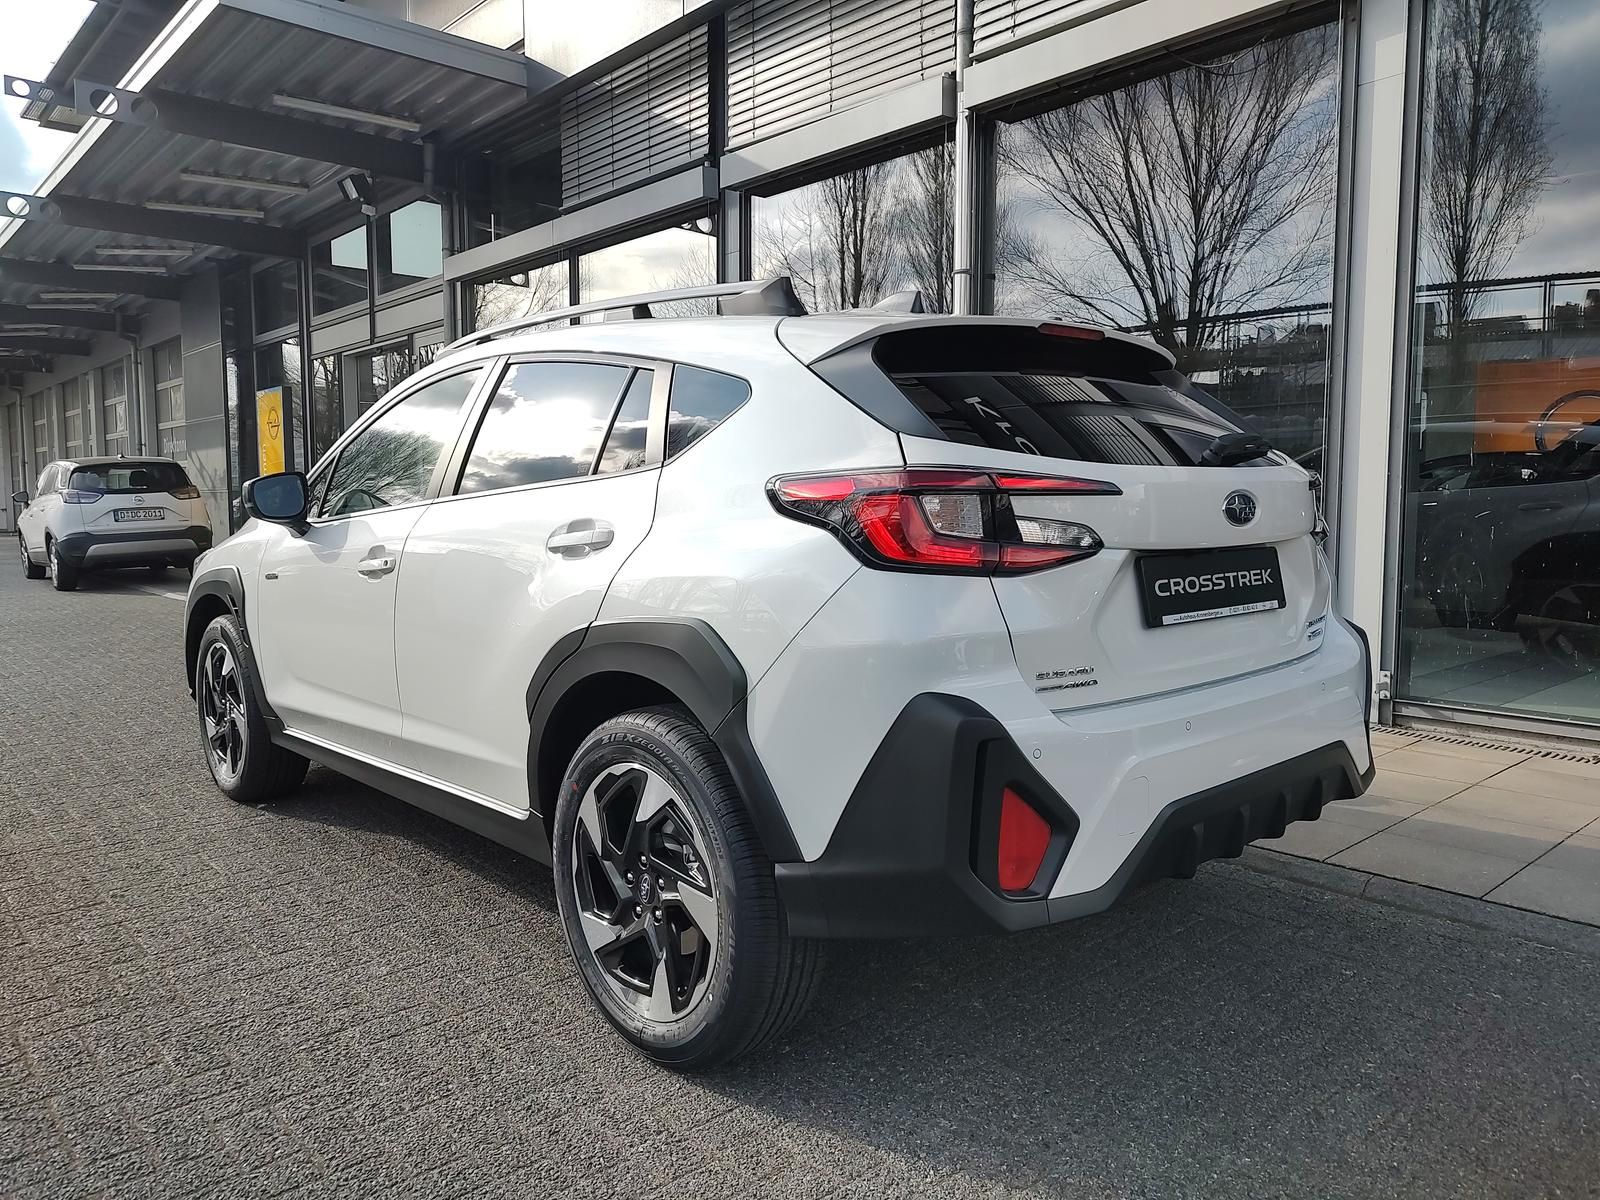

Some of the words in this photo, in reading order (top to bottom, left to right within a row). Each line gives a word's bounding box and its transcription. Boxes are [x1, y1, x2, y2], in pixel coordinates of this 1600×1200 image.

[143, 509, 163, 518] 2011
[1154, 568, 1274, 597] CROSSTREK
[601, 733, 637, 745] ZIEX
